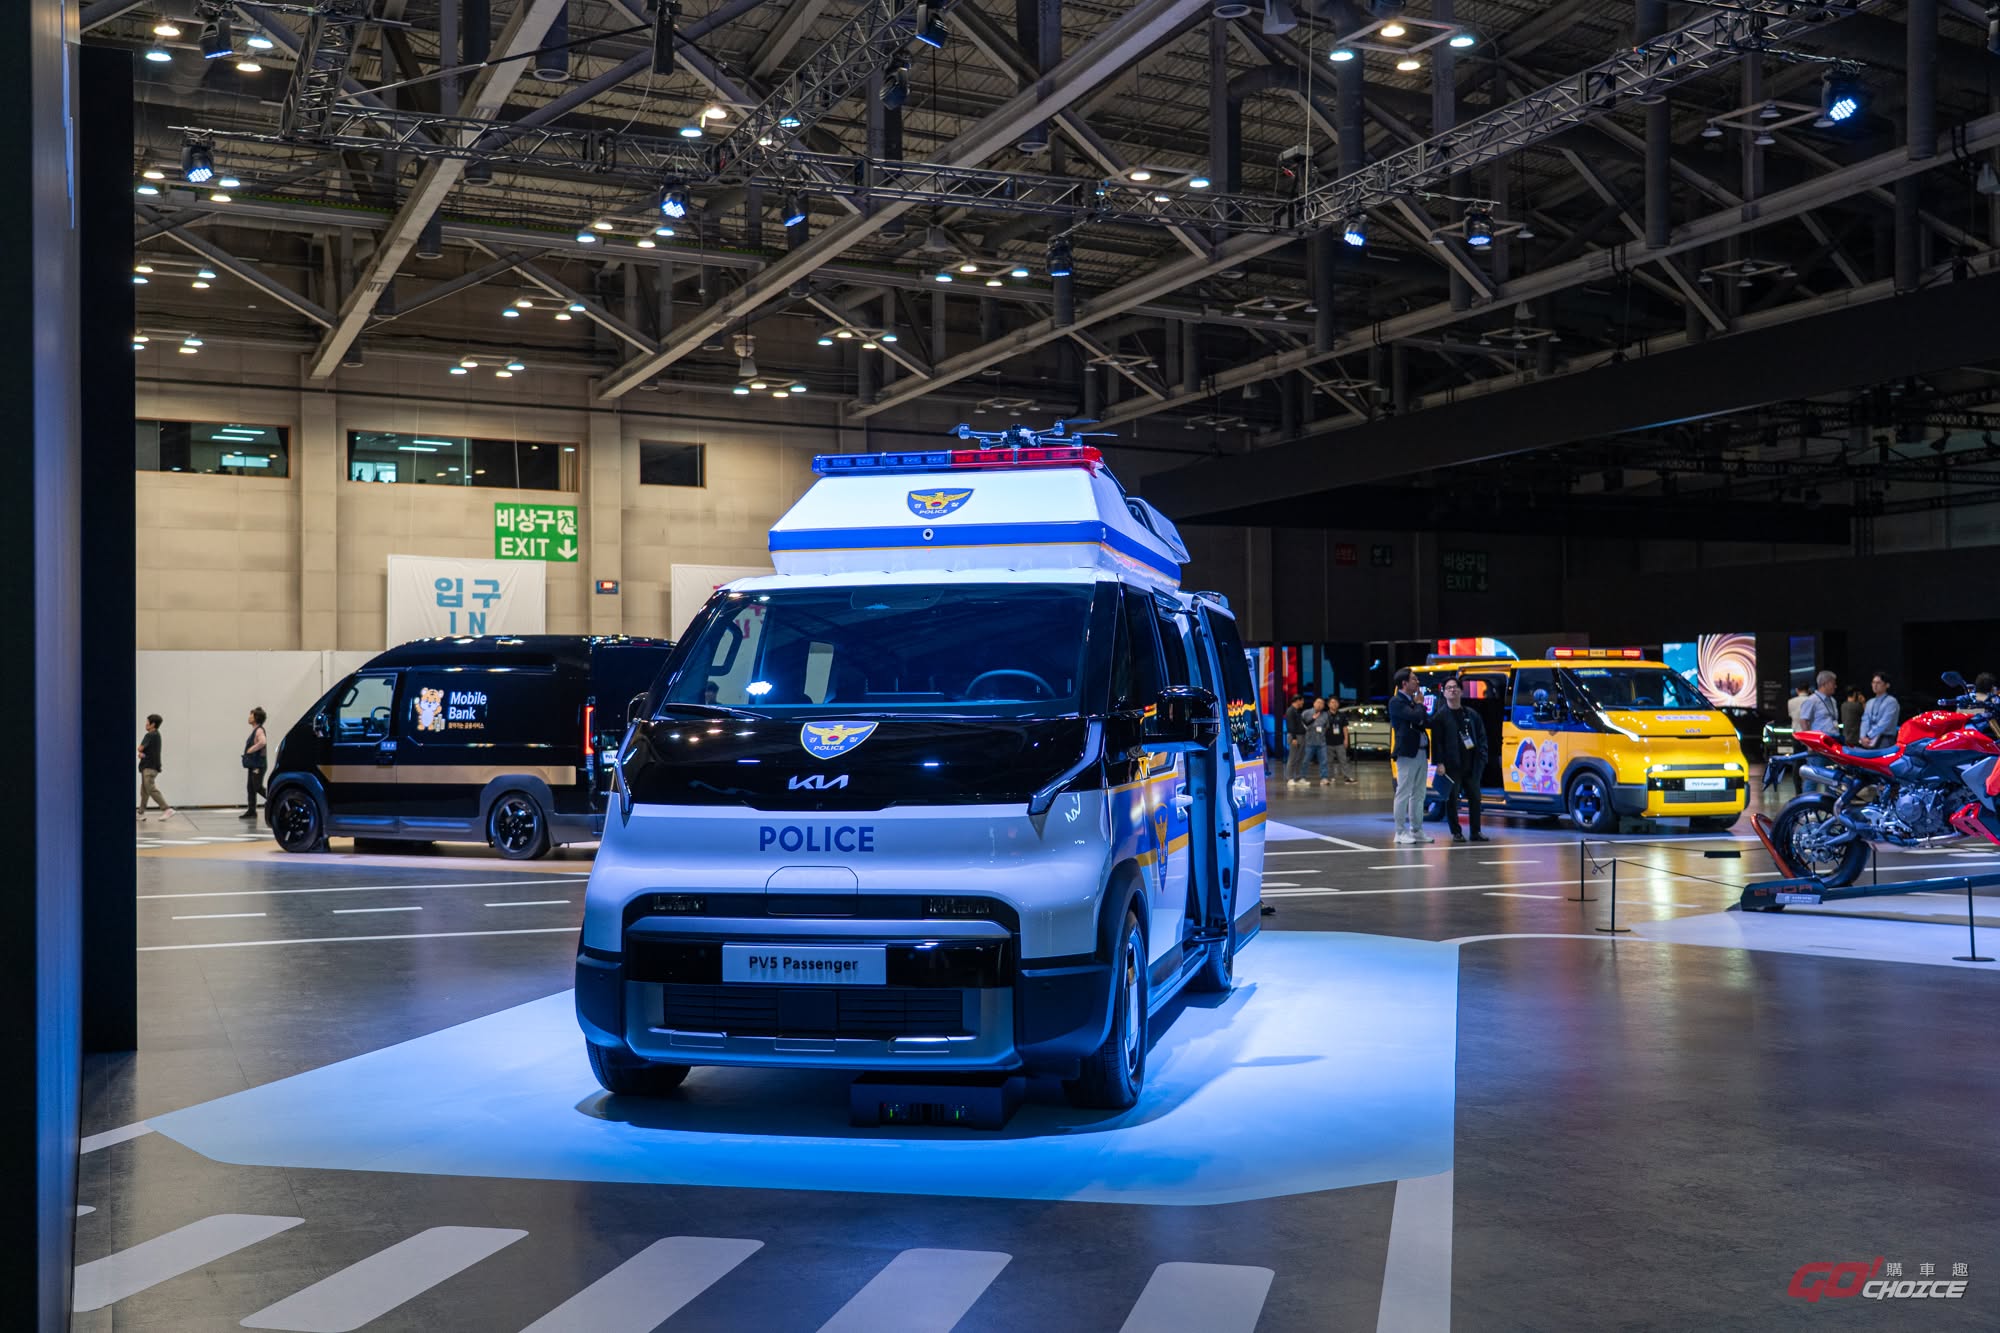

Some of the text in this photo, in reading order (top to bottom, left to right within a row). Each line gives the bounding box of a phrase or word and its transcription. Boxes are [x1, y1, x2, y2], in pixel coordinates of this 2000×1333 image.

[496, 508, 556, 533] 비상구
[501, 537, 550, 557] EXIT
[1447, 575, 1473, 589] EXIT
[434, 577, 502, 609] 입구
[449, 611, 487, 635] IN
[450, 691, 487, 705] Mobile
[448, 706, 476, 720] Bank
[788, 774, 849, 790] KIA
[759, 825, 874, 852] POLICE
[749, 956, 858, 974] PV5 Passenger
